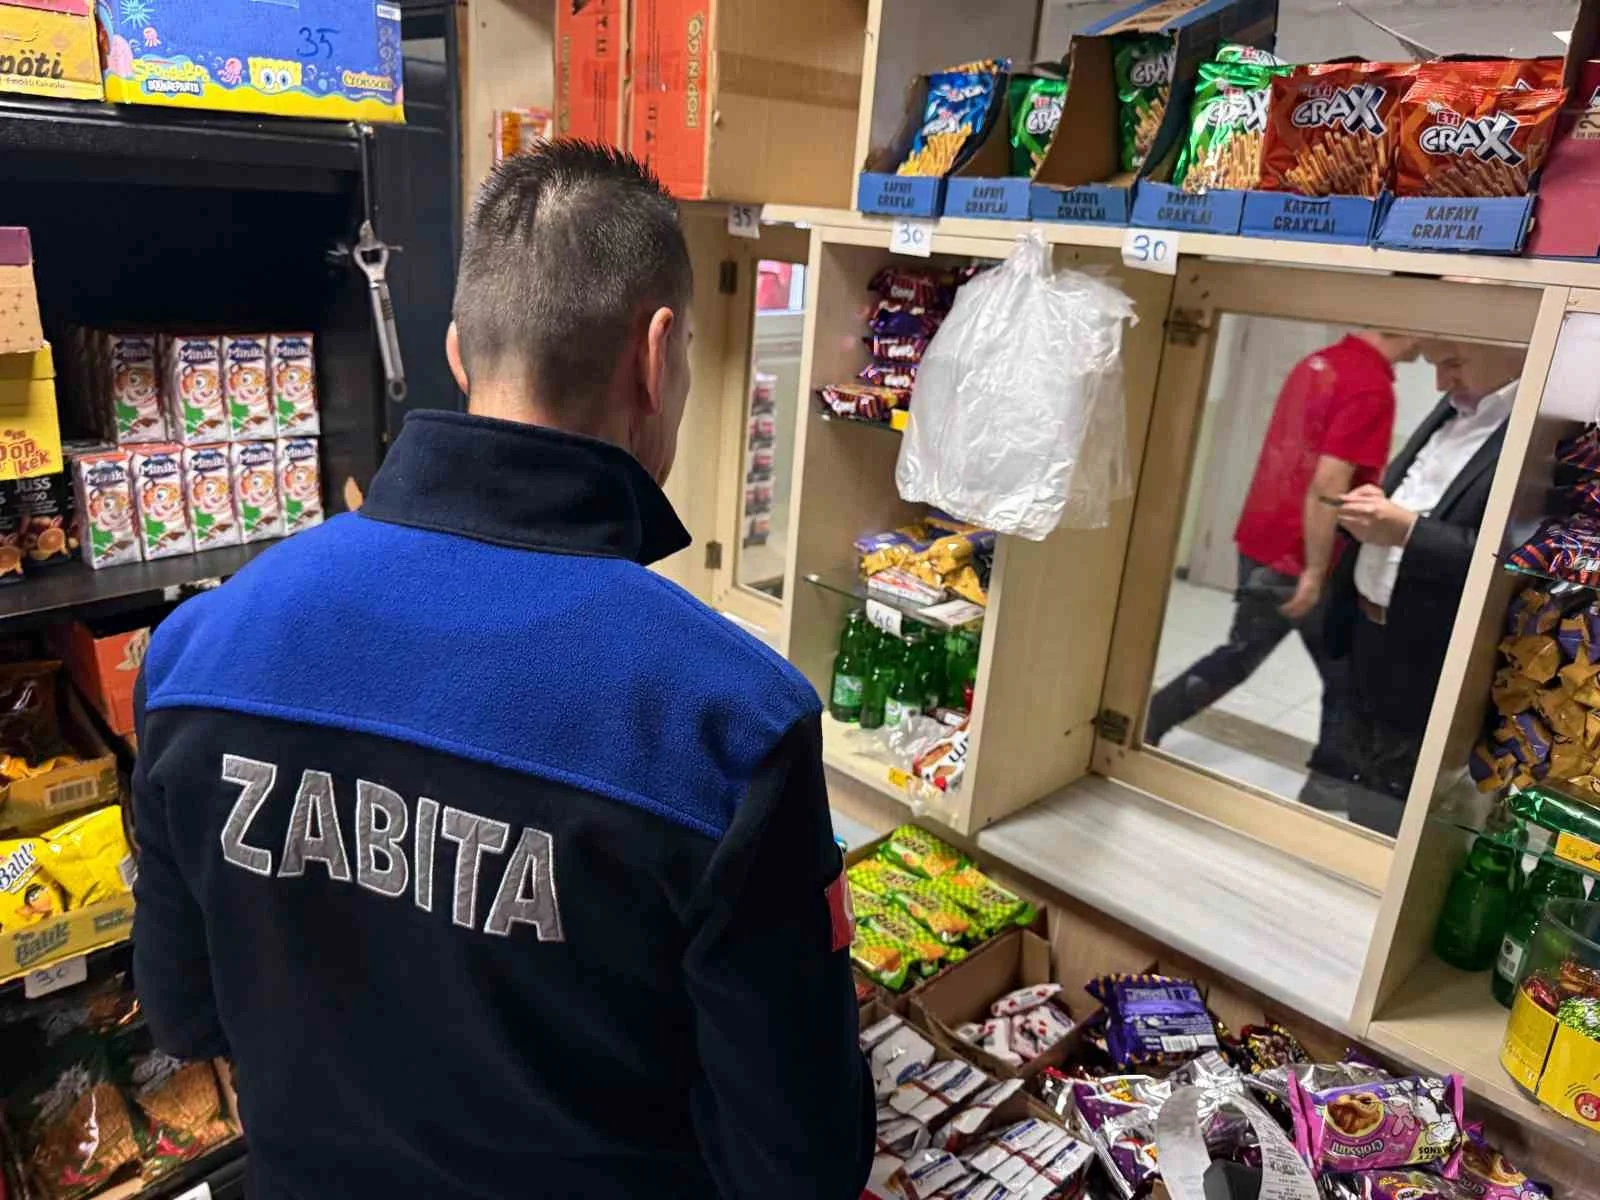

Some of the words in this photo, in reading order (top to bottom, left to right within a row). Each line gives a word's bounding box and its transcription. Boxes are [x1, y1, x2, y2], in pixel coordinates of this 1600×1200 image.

[296, 27, 339, 59] 35
[1291, 83, 1387, 137] CRAX
[1419, 111, 1527, 168] CRAX
[733, 206, 751, 228] 35
[1283, 199, 1330, 215] KAFAYI
[1424, 205, 1480, 222] KAFAYI
[900, 223, 924, 245] 30
[1411, 223, 1483, 242] CRAX'LA!
[1134, 234, 1168, 261] 30
[220, 753, 566, 943] ZABITA
